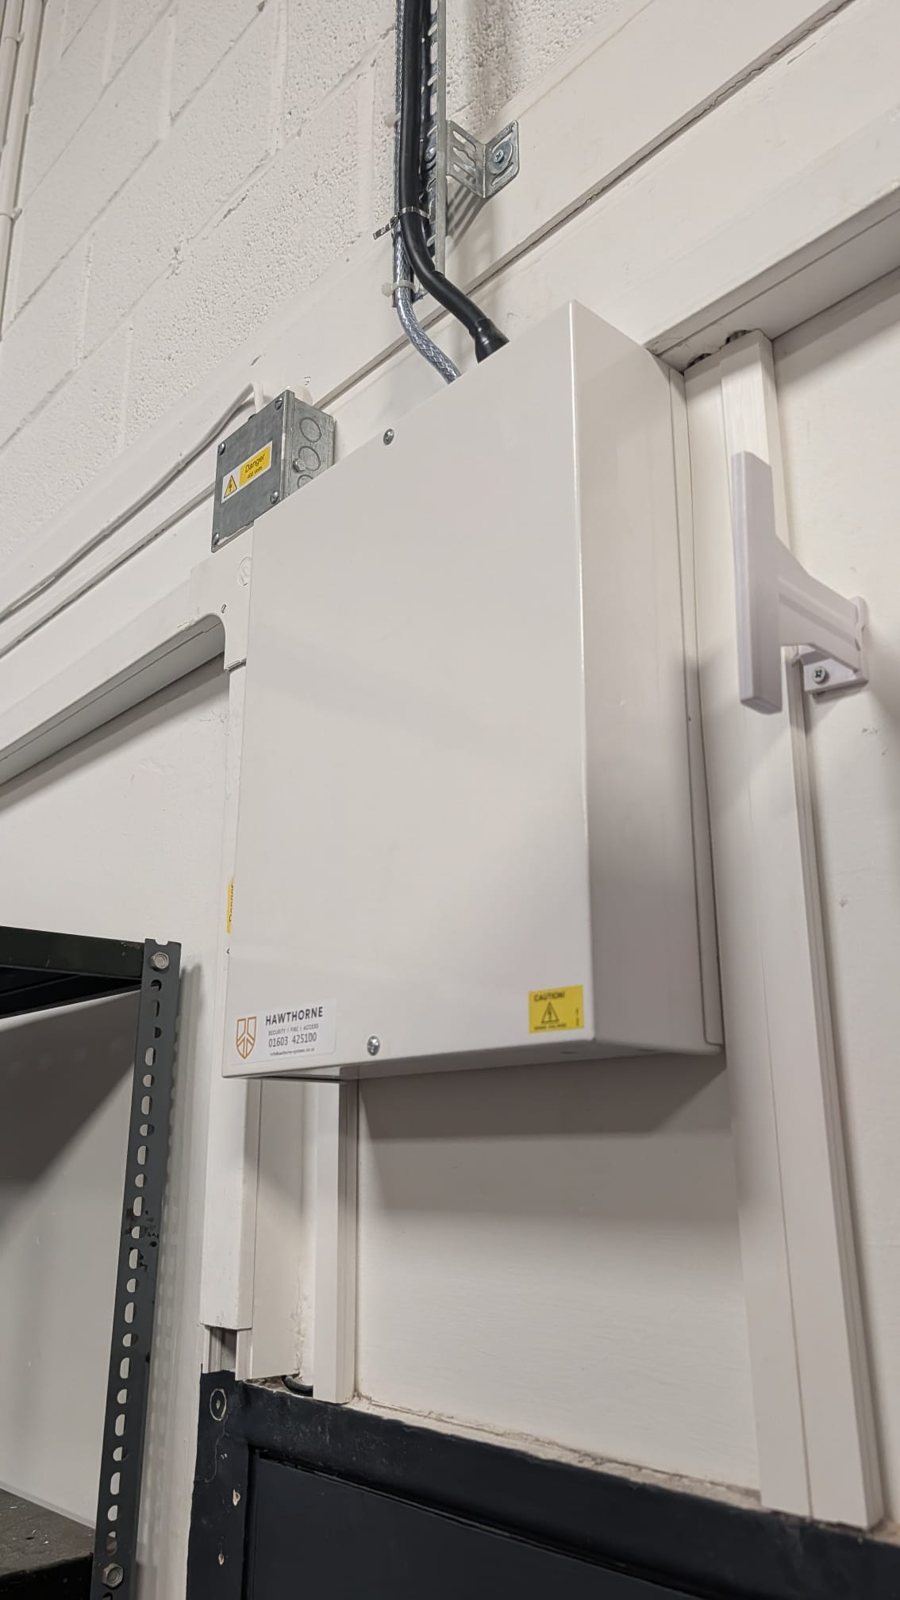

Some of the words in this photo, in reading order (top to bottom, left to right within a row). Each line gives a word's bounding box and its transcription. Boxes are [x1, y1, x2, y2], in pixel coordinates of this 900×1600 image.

[245, 453, 265, 473] Danger
[265, 1006, 323, 1026] HAWTHORNE
[268, 1036, 288, 1048] 01603
[292, 1032, 317, 1045] 425100
